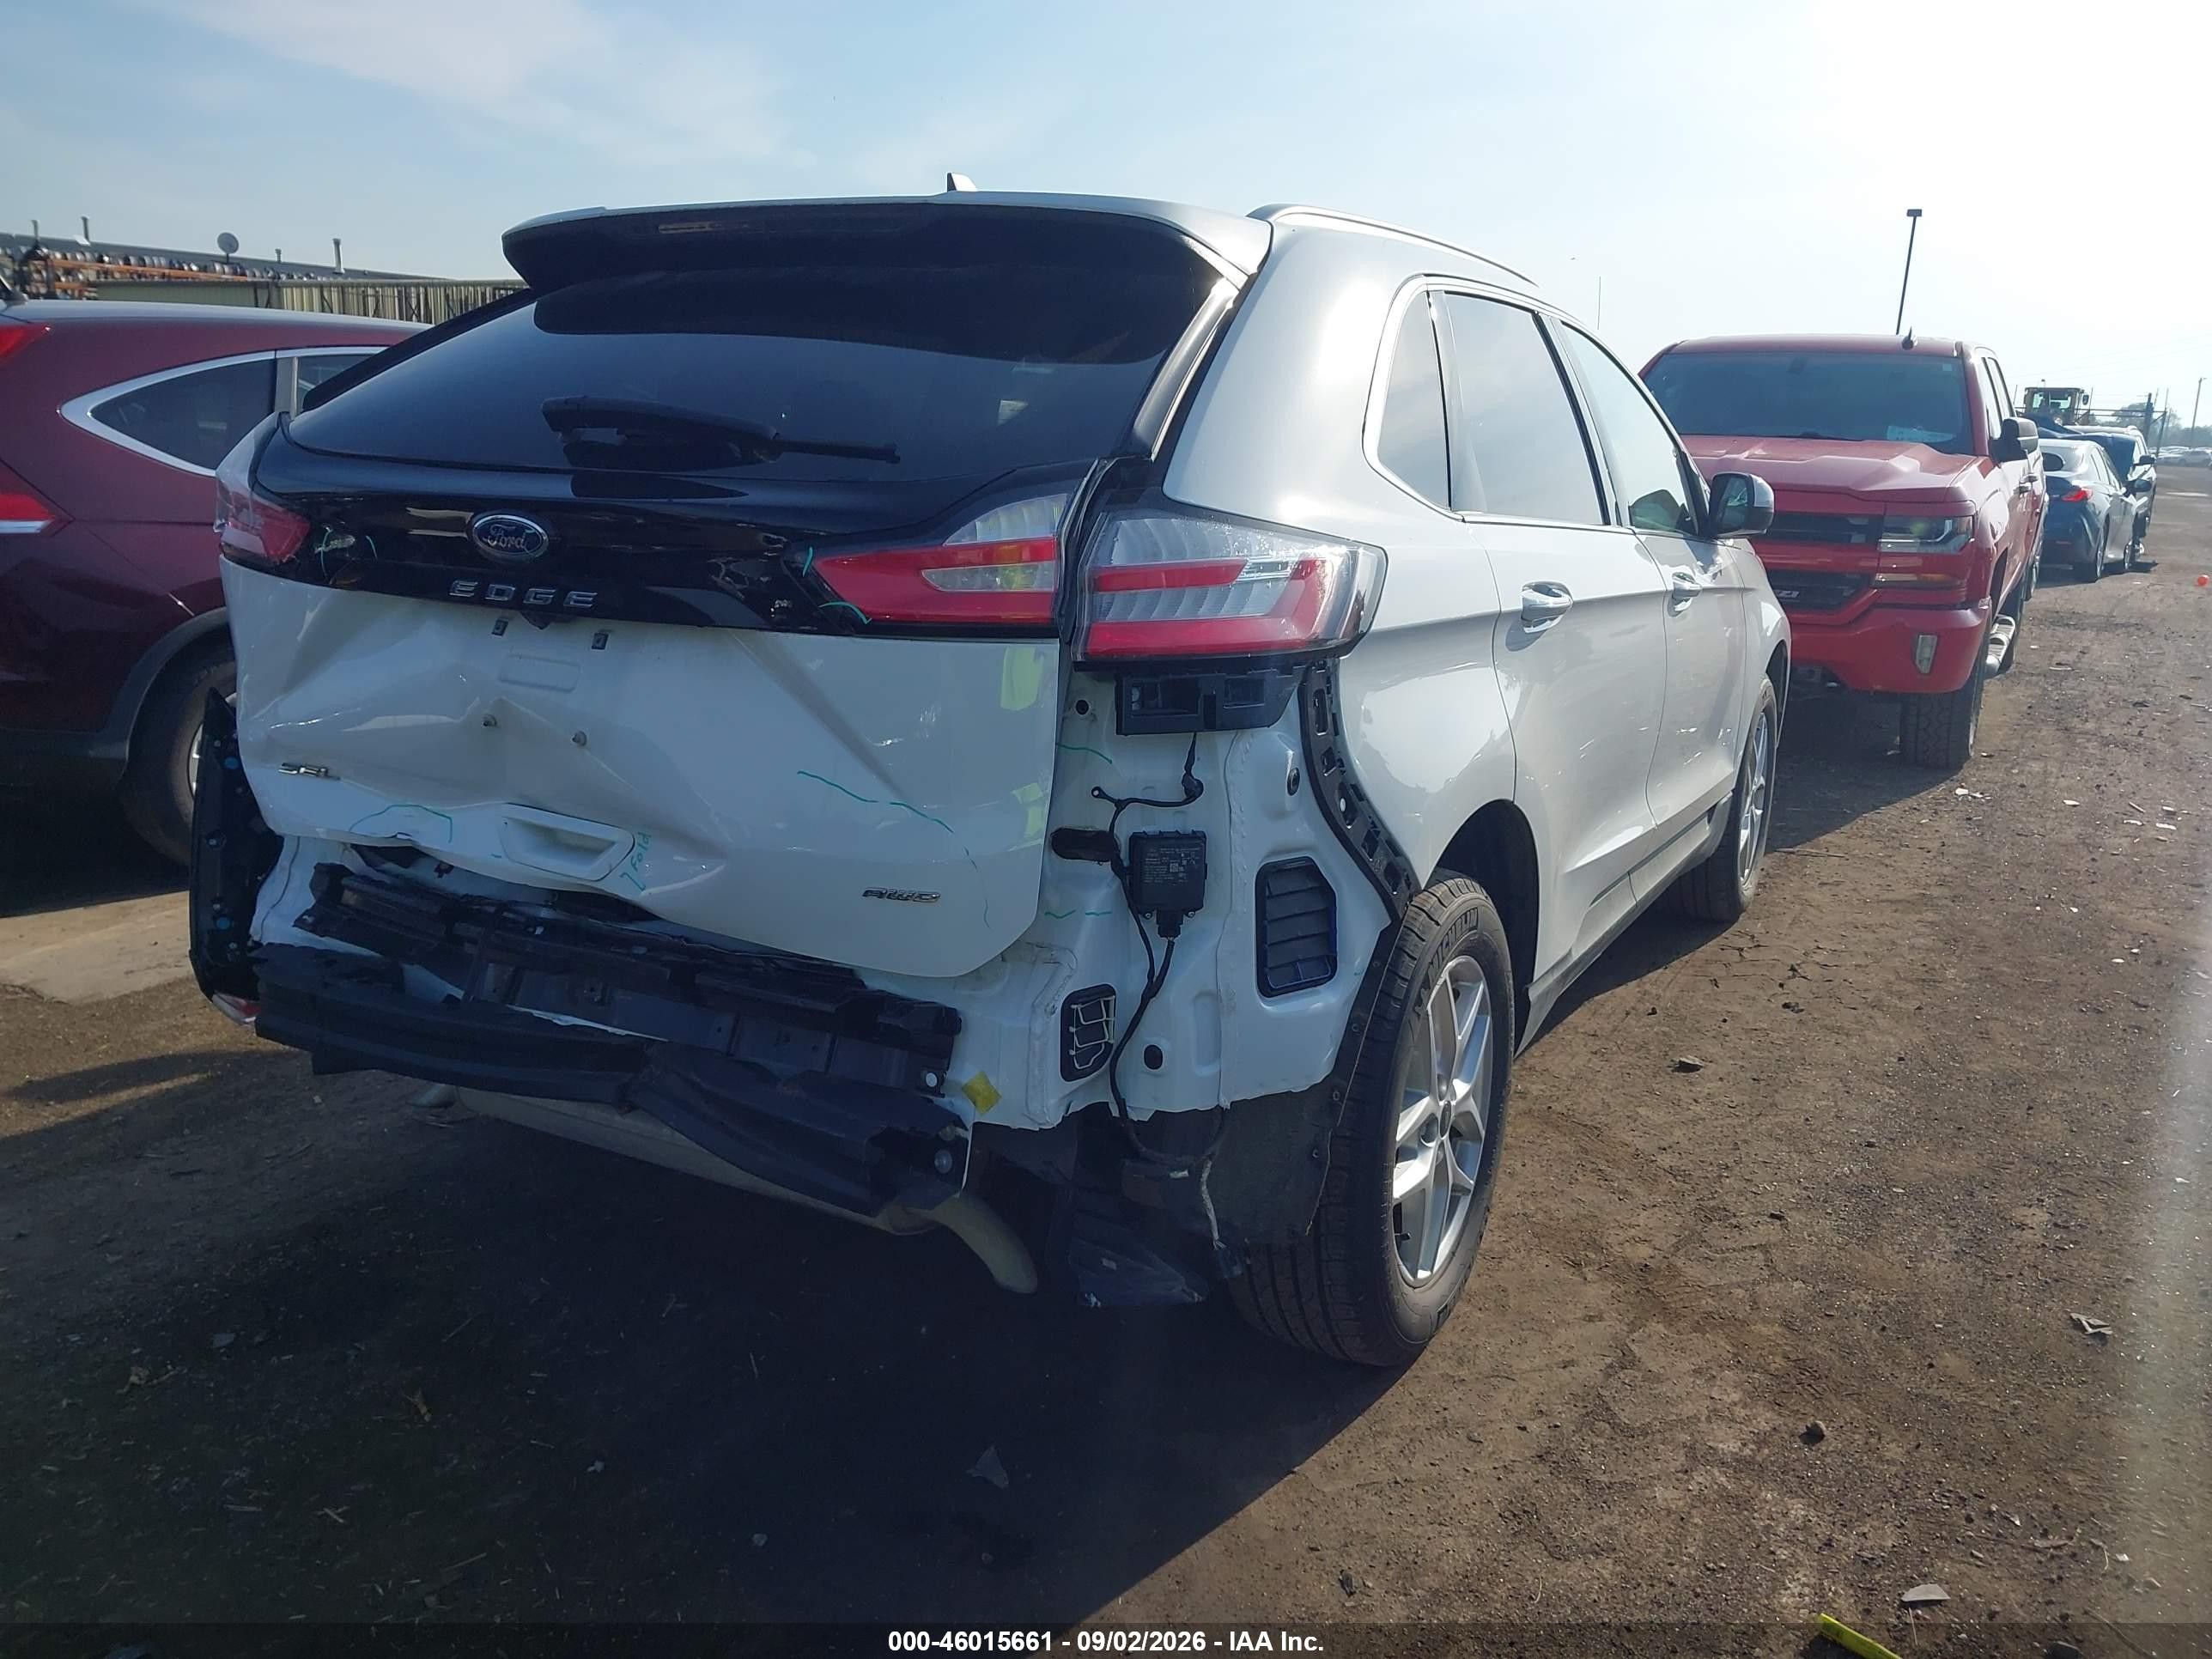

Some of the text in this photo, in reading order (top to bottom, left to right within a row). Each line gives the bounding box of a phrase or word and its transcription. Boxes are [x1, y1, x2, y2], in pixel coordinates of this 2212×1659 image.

[482, 524, 531, 550] Ford
[449, 580, 598, 608] EDGE
[861, 887, 942, 903] AWD
